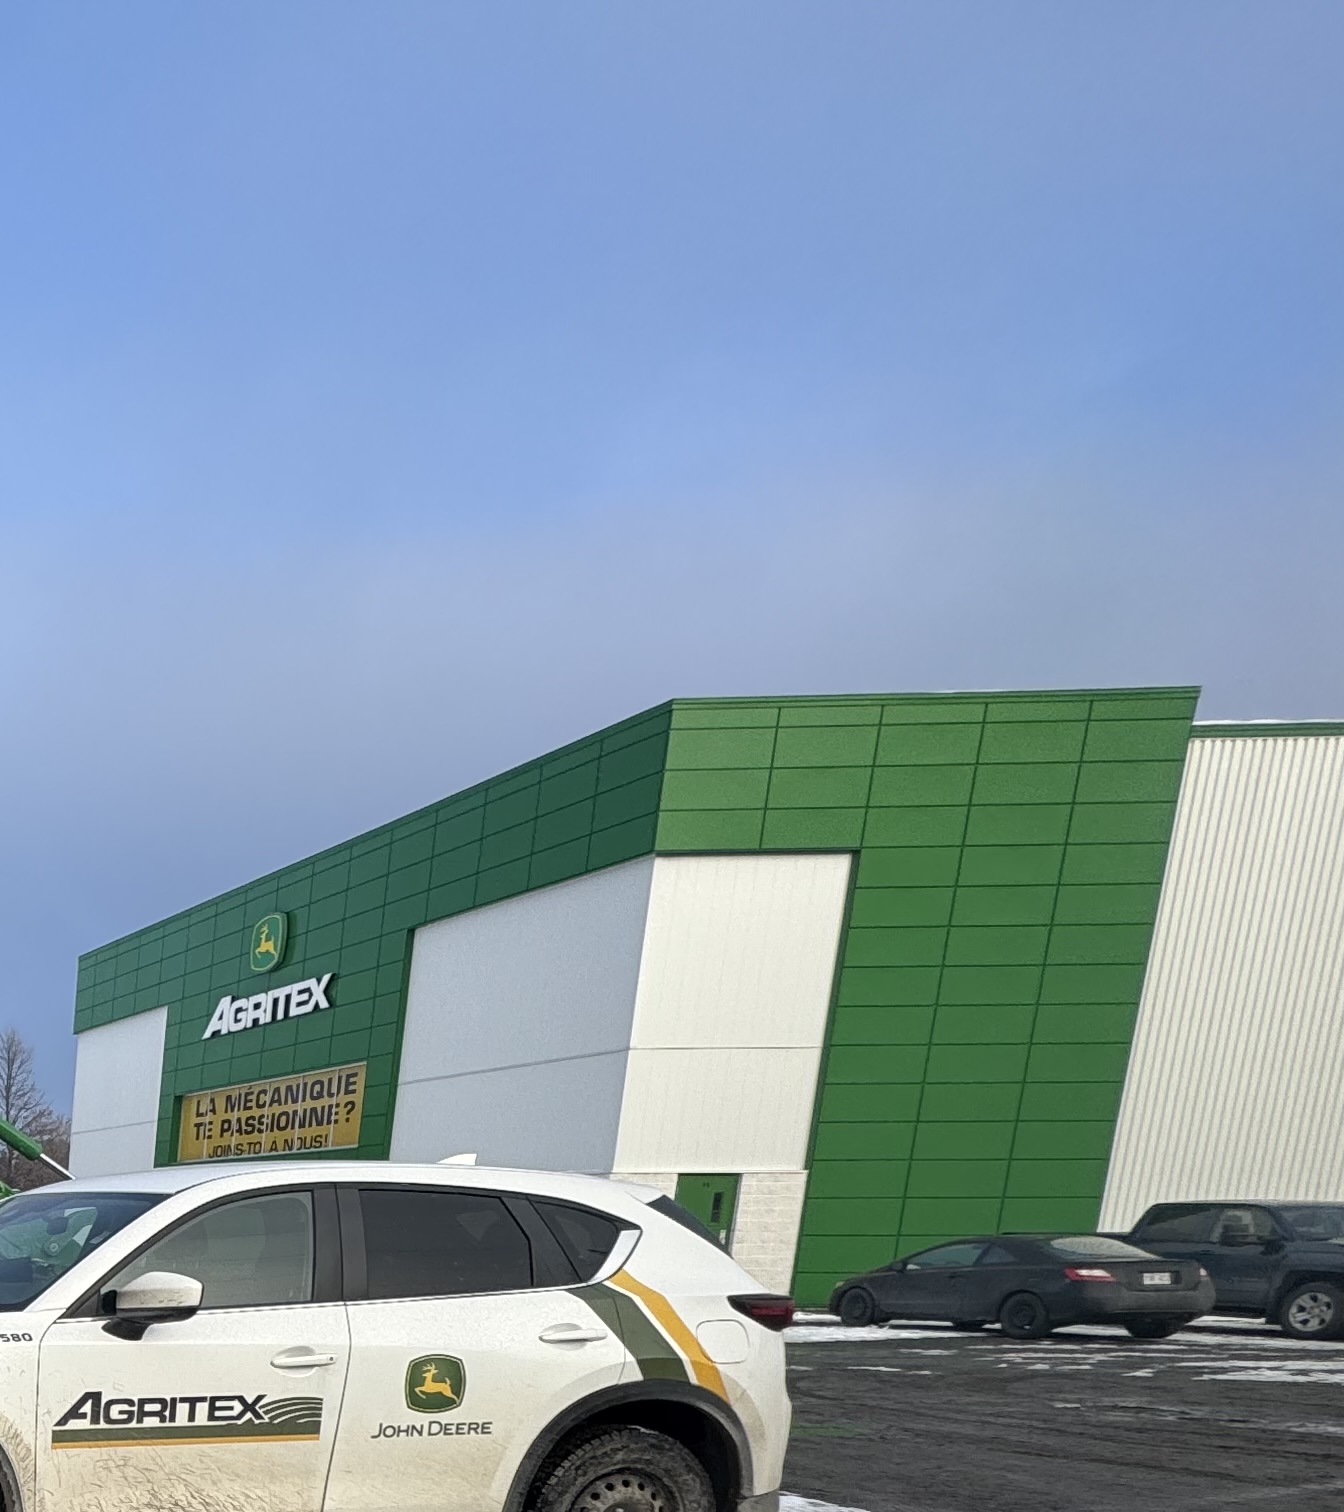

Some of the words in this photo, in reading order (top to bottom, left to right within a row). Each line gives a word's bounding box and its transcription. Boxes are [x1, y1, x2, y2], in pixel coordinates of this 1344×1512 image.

[201, 972, 333, 1040] AGRITEX
[195, 1097, 216, 1119] LA
[224, 1072, 359, 1114] MÉCANIQUE
[193, 1121, 213, 1141] TE
[208, 1139, 265, 1159] JOINS-TO
[52, 1390, 268, 1427] AGRITEX
[370, 1422, 424, 1439] JOHN
[427, 1420, 493, 1437] DEERE
